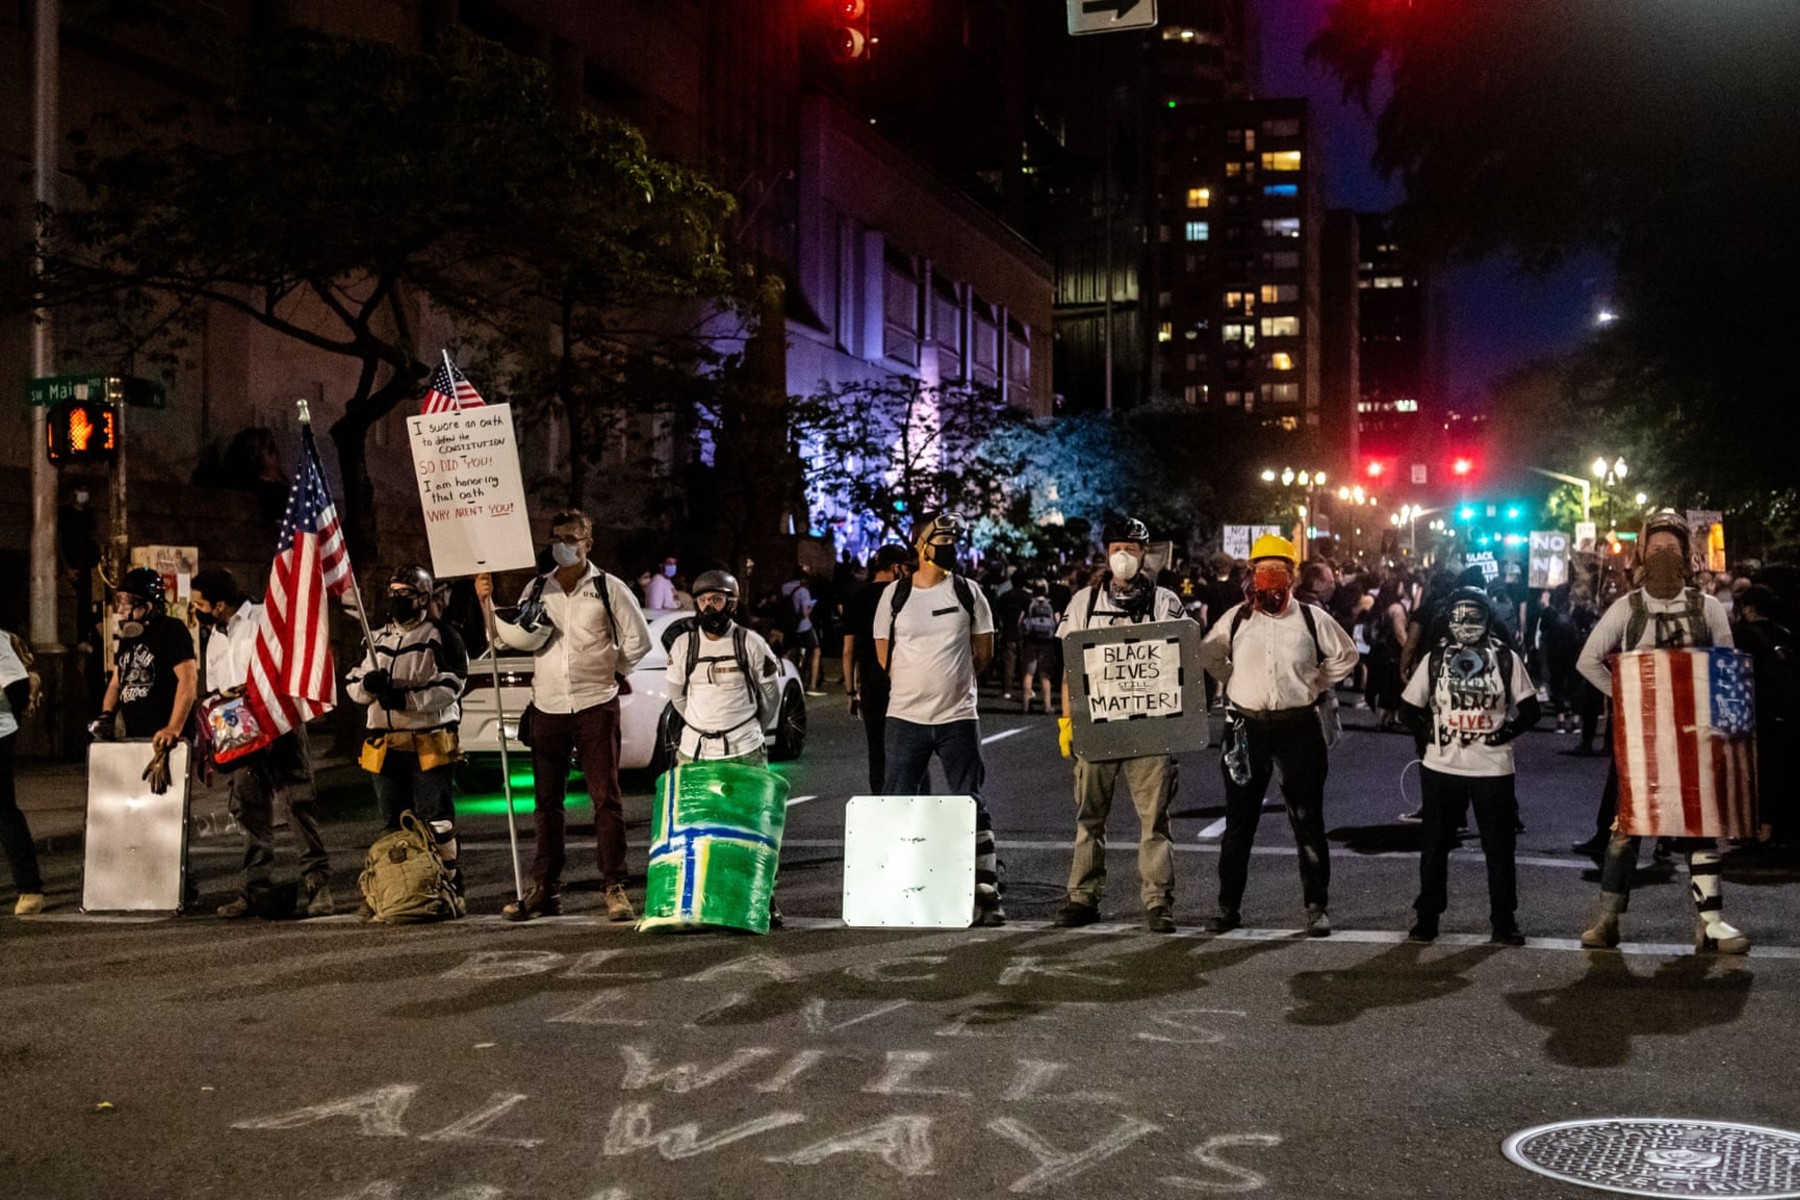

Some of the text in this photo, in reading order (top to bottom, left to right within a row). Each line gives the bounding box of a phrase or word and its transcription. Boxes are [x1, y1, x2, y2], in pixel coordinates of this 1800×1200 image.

[31, 389, 43, 401] SW
[49, 381, 77, 400] Mai
[413, 415, 503, 436] I swore an oath
[422, 437, 432, 447] to
[459, 433, 469, 441] the
[439, 438, 505, 454] CONSTITUTION
[419, 457, 493, 475] SO DID YOU!
[424, 476, 499, 493] I am honoring
[432, 487, 484, 503] that oath
[427, 509, 449, 523] WHY
[488, 502, 515, 516] YOU!
[1532, 534, 1566, 551] NO
[1104, 645, 1161, 663] BLACK
[1104, 663, 1160, 680] LIVES
[1118, 681, 1151, 690] STILL
[1090, 693, 1178, 713] MATTER!
[1449, 714, 1494, 730] LIVES
[440, 950, 1124, 985] BLACK
[1590, 1170, 1763, 1191] ELECTRIC
